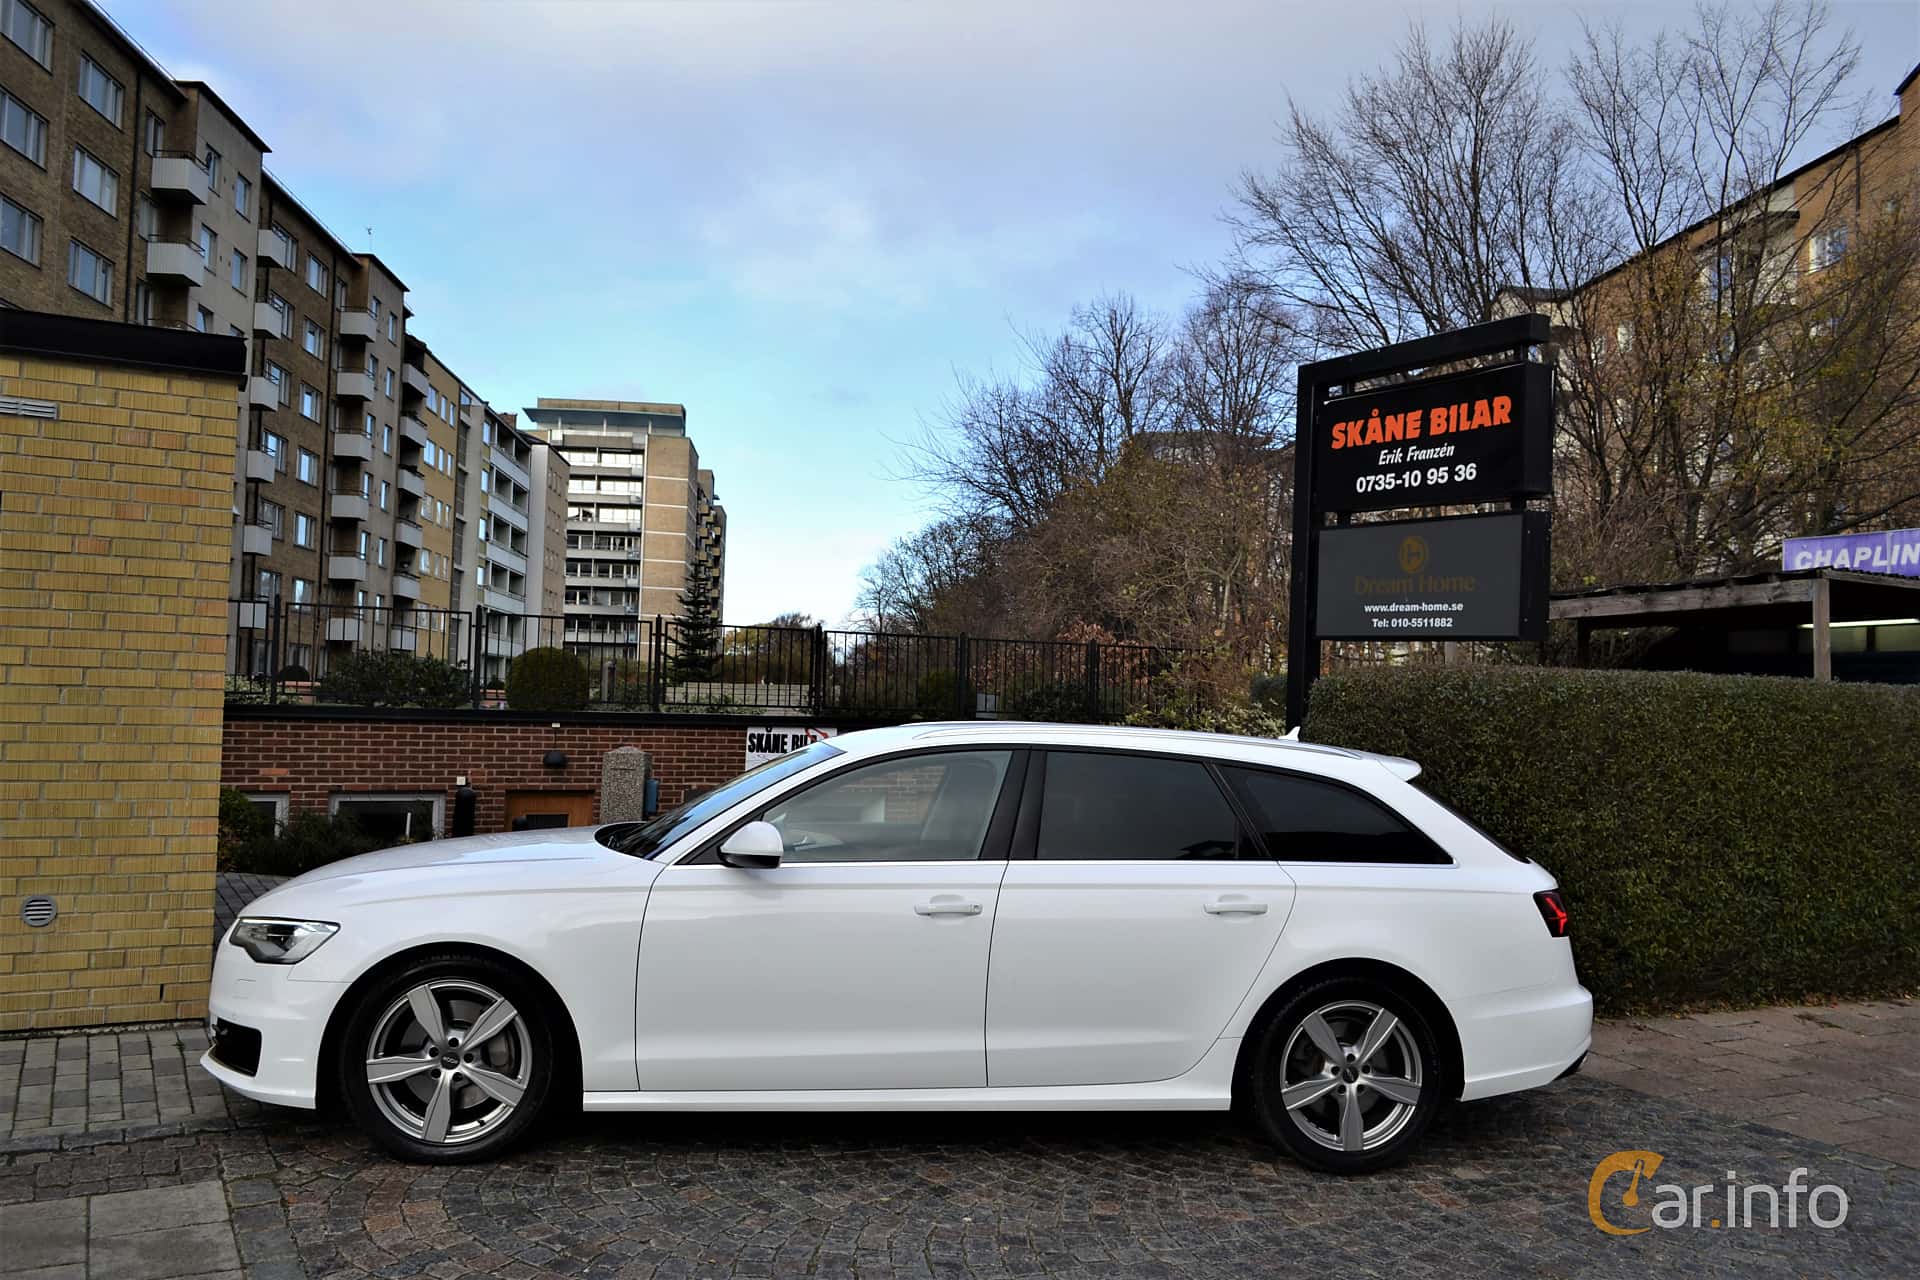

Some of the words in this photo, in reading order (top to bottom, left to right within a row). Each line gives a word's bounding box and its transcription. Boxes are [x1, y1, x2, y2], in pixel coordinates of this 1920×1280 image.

[1331, 408, 1422, 449] SKÅNE
[1429, 395, 1512, 436] BILAR
[1378, 447, 1403, 465] Erik
[1406, 442, 1455, 462] Franzén
[1356, 470, 1422, 493] 0735-10
[1426, 466, 1449, 485] 95
[1454, 463, 1477, 482] 36
[1794, 543, 1920, 571] CHAPLIN
[1364, 602, 1464, 613] www.dream-home.se
[1371, 618, 1390, 629] Tel:
[1391, 617, 1453, 628] 010-5511882
[748, 728, 788, 753] SKÅNE
